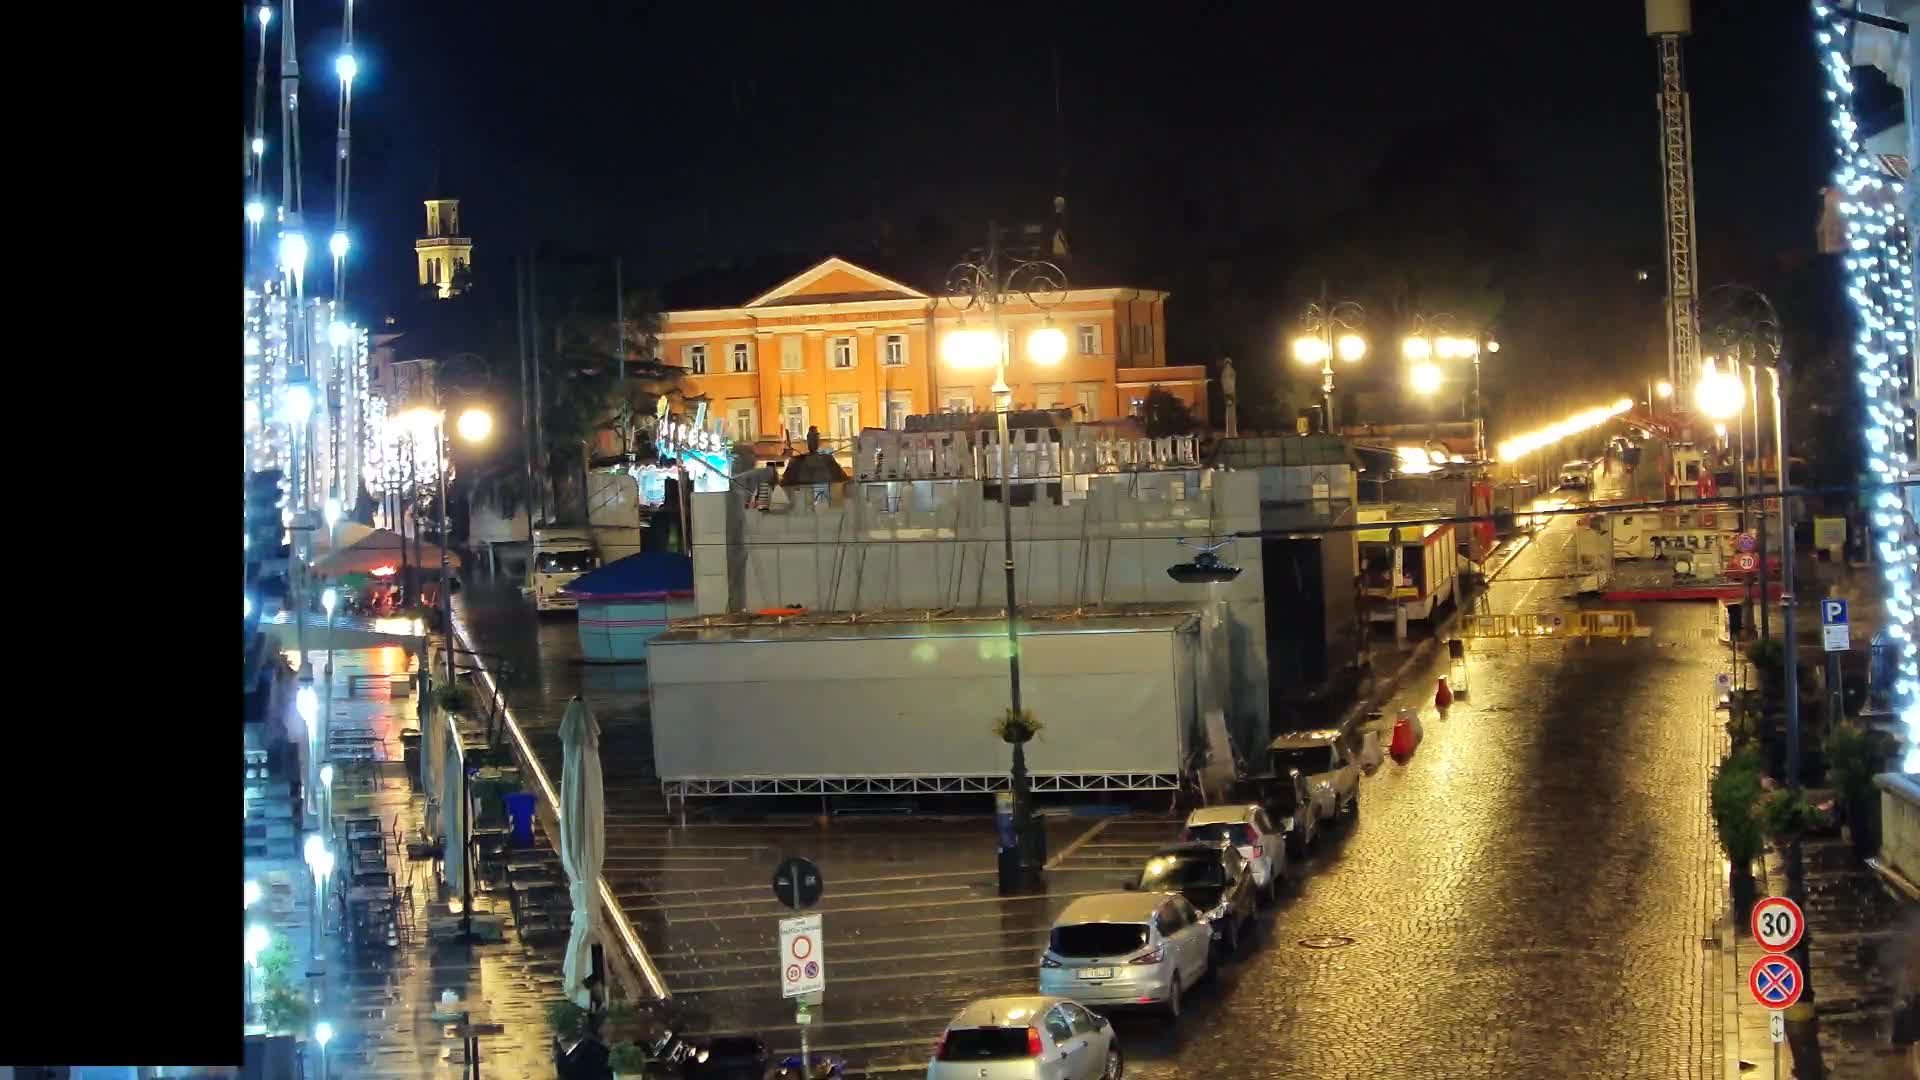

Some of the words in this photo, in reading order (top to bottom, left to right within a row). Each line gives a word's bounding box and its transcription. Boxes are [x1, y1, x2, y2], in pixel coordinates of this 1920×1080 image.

[1742, 558, 1752, 567] 20
[1827, 602, 1841, 621] P
[1762, 912, 1791, 937] 30
